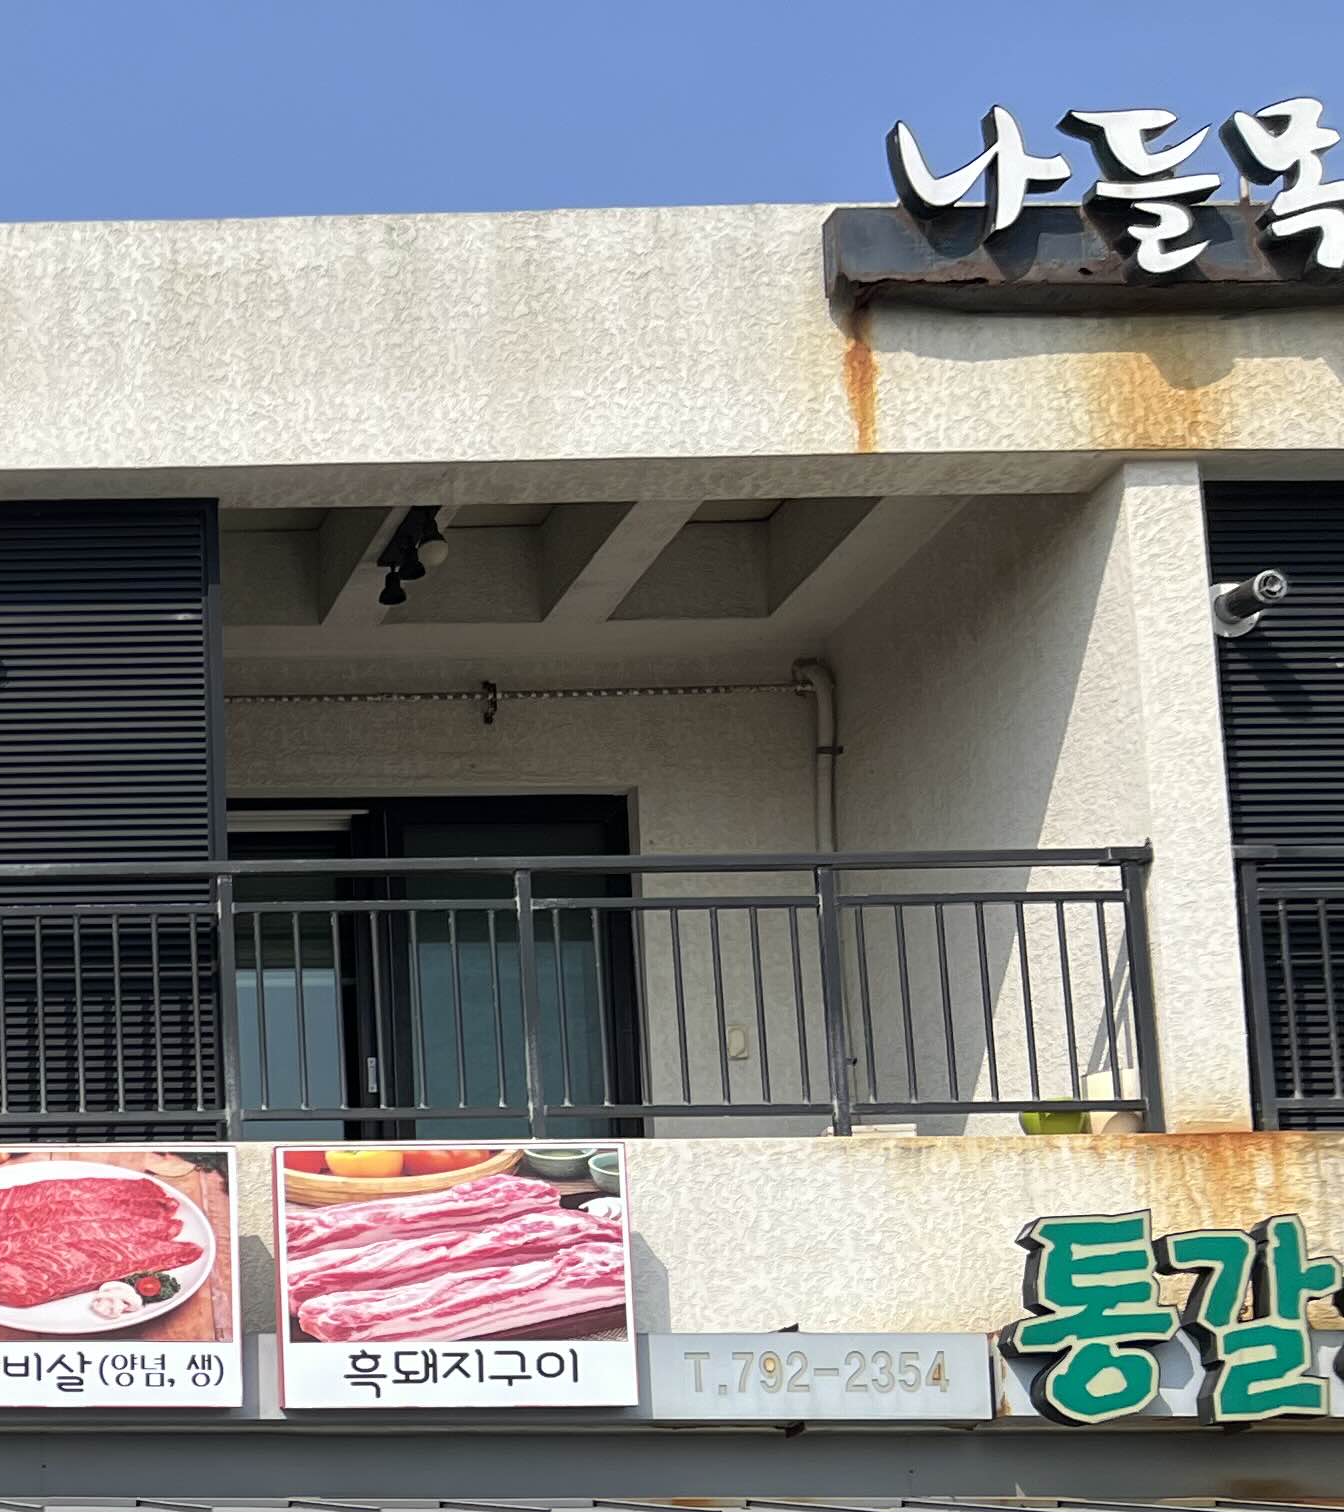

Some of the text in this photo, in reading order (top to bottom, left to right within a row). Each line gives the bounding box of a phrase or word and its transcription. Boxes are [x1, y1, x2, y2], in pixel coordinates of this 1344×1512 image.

[888, 97, 1344, 274] 나들목
[1010, 1209, 1343, 1425] 통갈
[185, 1350, 226, 1390] 생)
[344, 1347, 580, 1399] 흑돼지구이
[683, 1349, 951, 1396] T.792-2354
